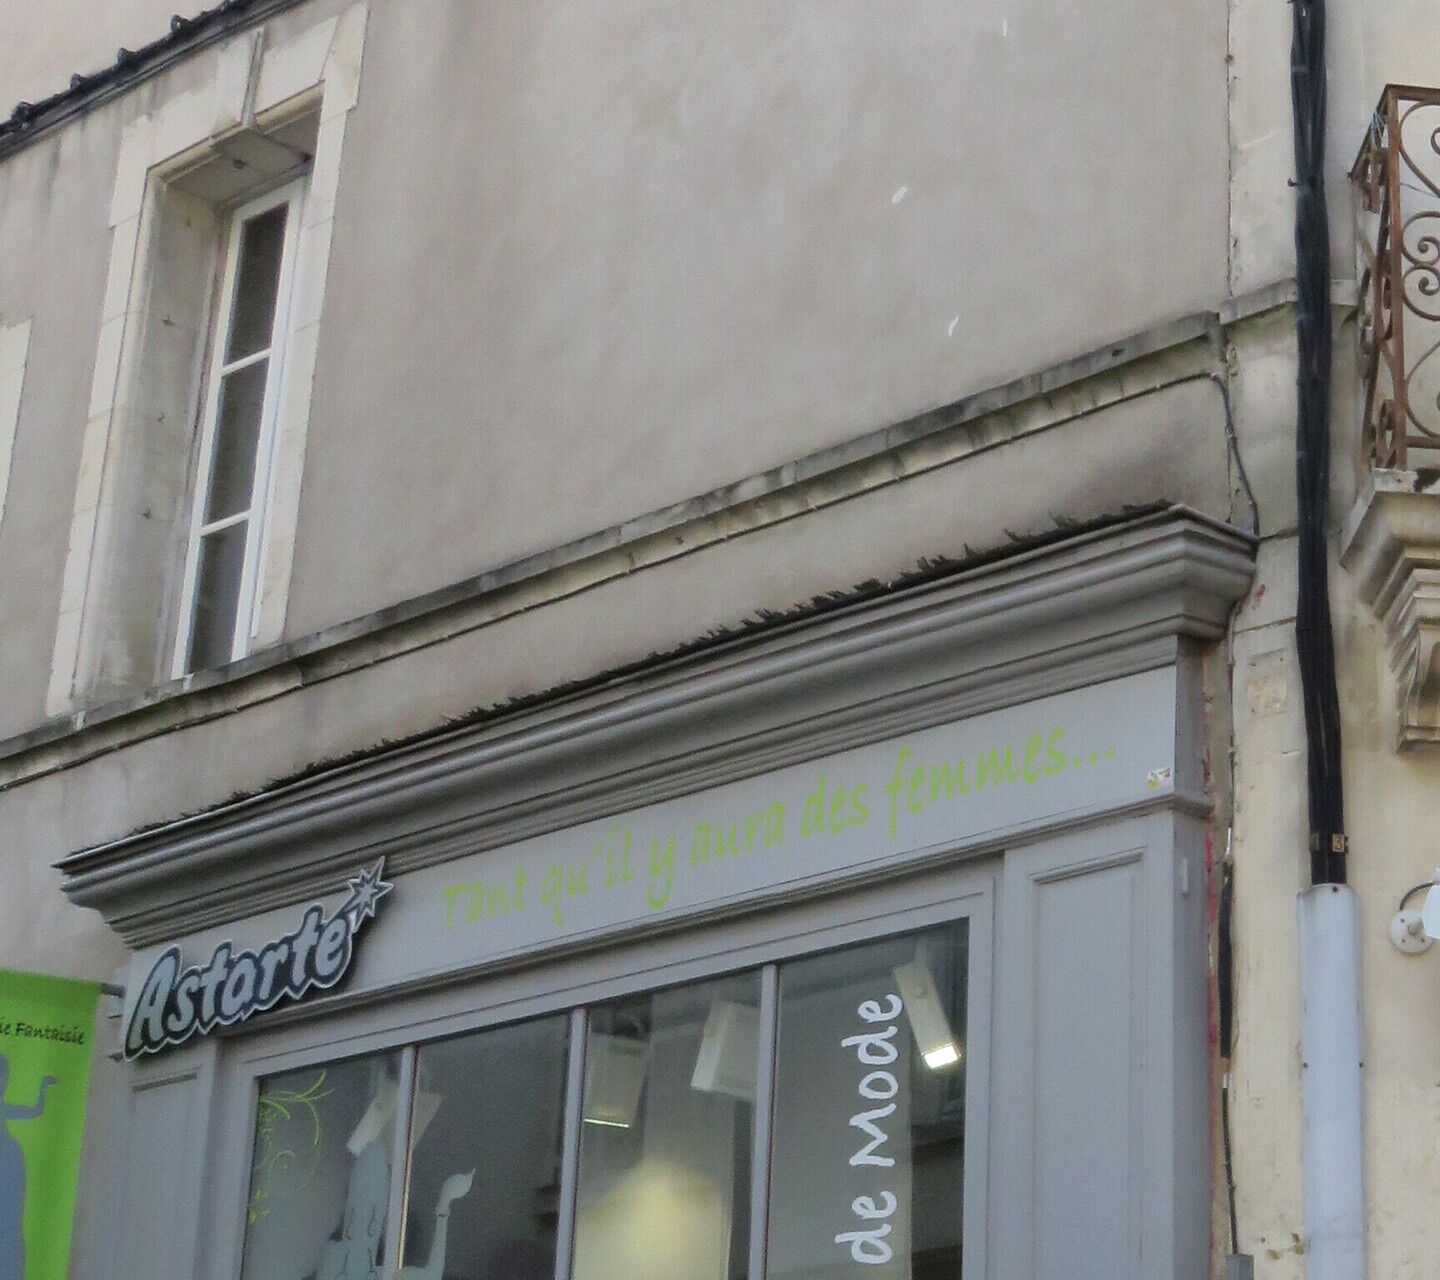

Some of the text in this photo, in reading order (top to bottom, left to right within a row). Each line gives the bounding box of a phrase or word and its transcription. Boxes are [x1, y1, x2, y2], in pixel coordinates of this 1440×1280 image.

[441, 864, 529, 928] Tant
[647, 832, 676, 909] y
[689, 800, 785, 865] aura
[800, 772, 870, 838] des
[841, 993, 903, 1167] Mode
[834, 1190, 898, 1264] de
